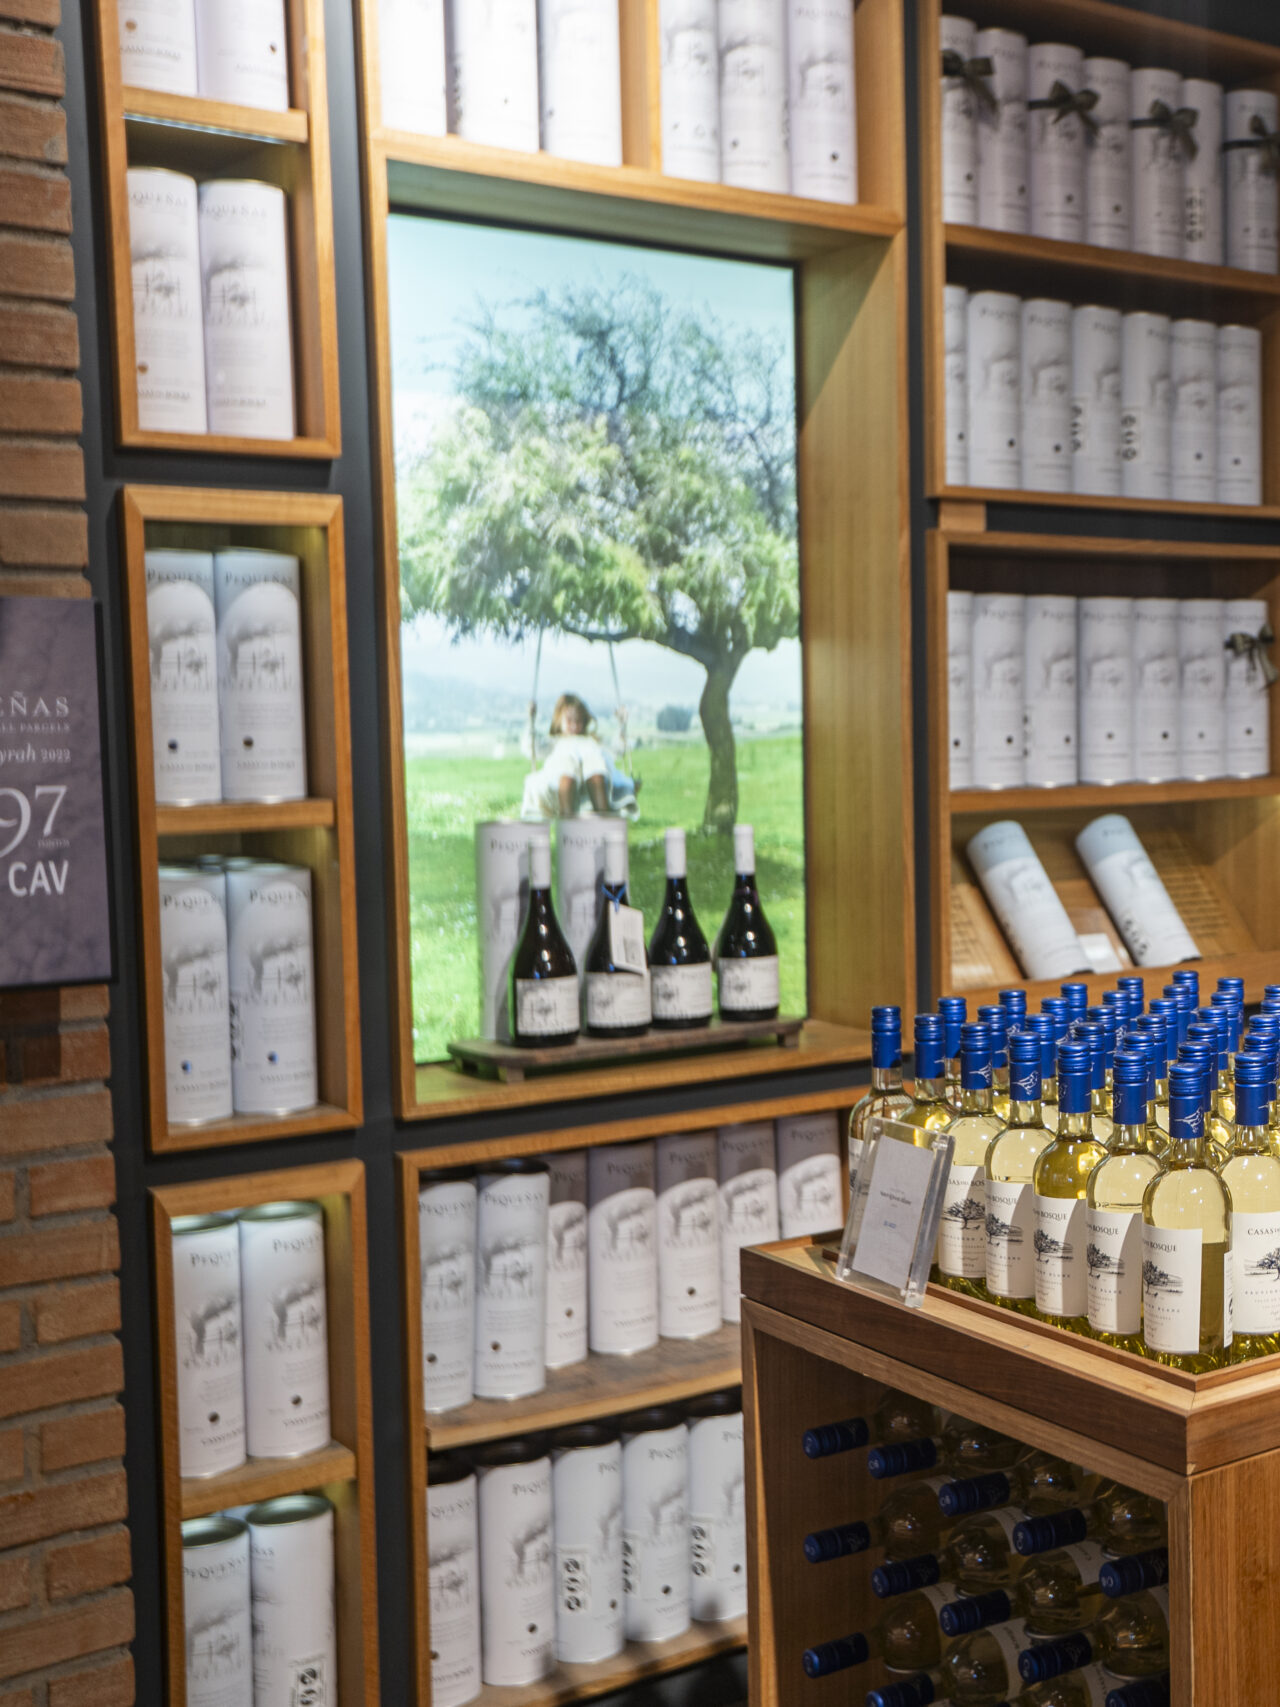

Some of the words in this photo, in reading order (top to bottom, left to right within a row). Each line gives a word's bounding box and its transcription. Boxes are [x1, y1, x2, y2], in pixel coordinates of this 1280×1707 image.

[8, 860, 69, 898] CAV
[1040, 1209, 1068, 1222] BOSQUE
[1092, 1222, 1119, 1238] BOSQUE
[1247, 1226, 1274, 1237] CASAS
[1150, 1239, 1178, 1254] BOSQUE
